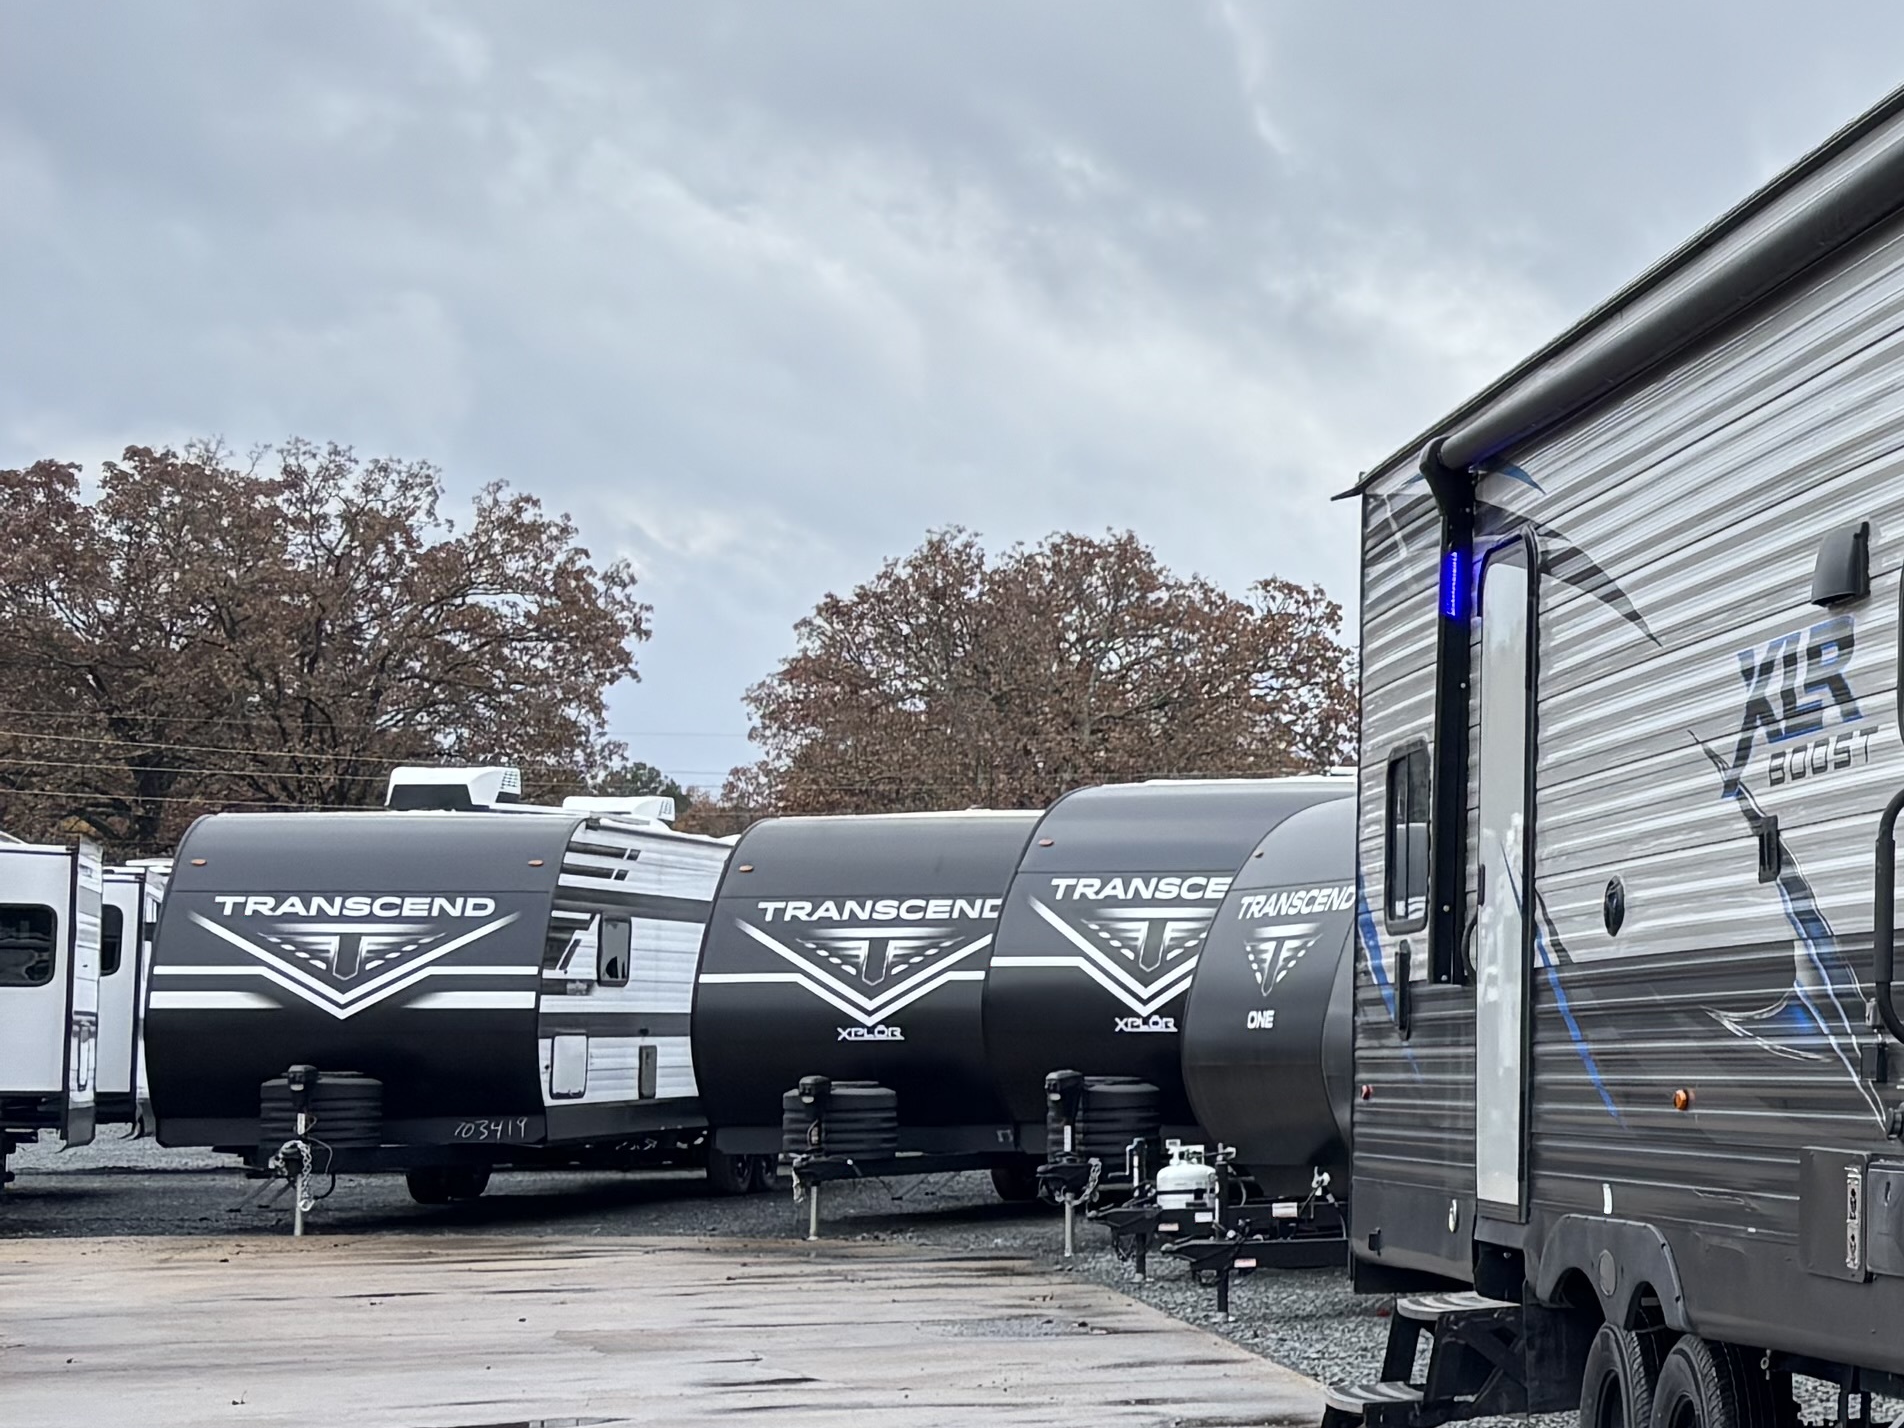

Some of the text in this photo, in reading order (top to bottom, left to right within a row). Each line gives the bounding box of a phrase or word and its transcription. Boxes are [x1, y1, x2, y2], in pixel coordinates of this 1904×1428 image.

[1722, 615, 1864, 800] XLR
[1768, 725, 1879, 788] BOOST
[1050, 876, 1234, 900] TRANSCE
[1237, 885, 1355, 920] TRANSCEND
[214, 895, 496, 917] TRANSCEND
[1247, 1009, 1275, 1029] ONE
